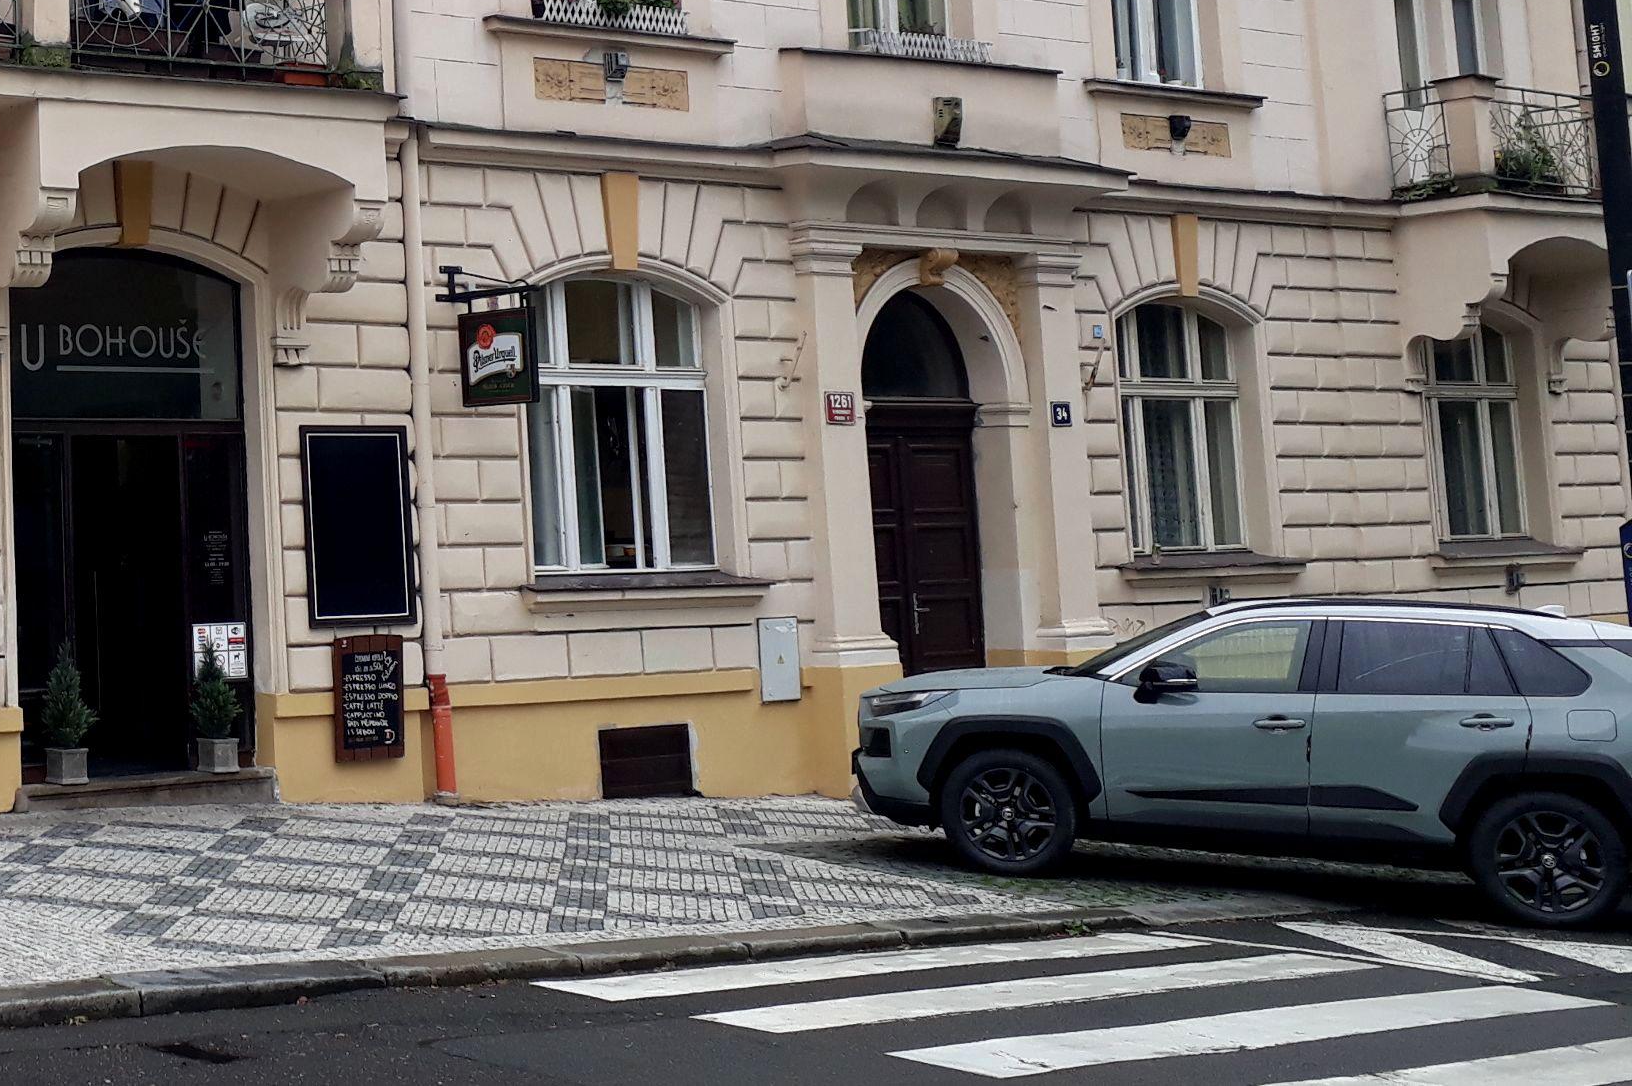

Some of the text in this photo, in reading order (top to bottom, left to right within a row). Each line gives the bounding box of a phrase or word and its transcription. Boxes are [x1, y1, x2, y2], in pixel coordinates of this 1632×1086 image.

[1590, 23, 1602, 59] SMIGHT
[20, 319, 208, 372] U BOHOUŠE
[829, 395, 852, 409] 1261
[1056, 407, 1068, 421] 34
